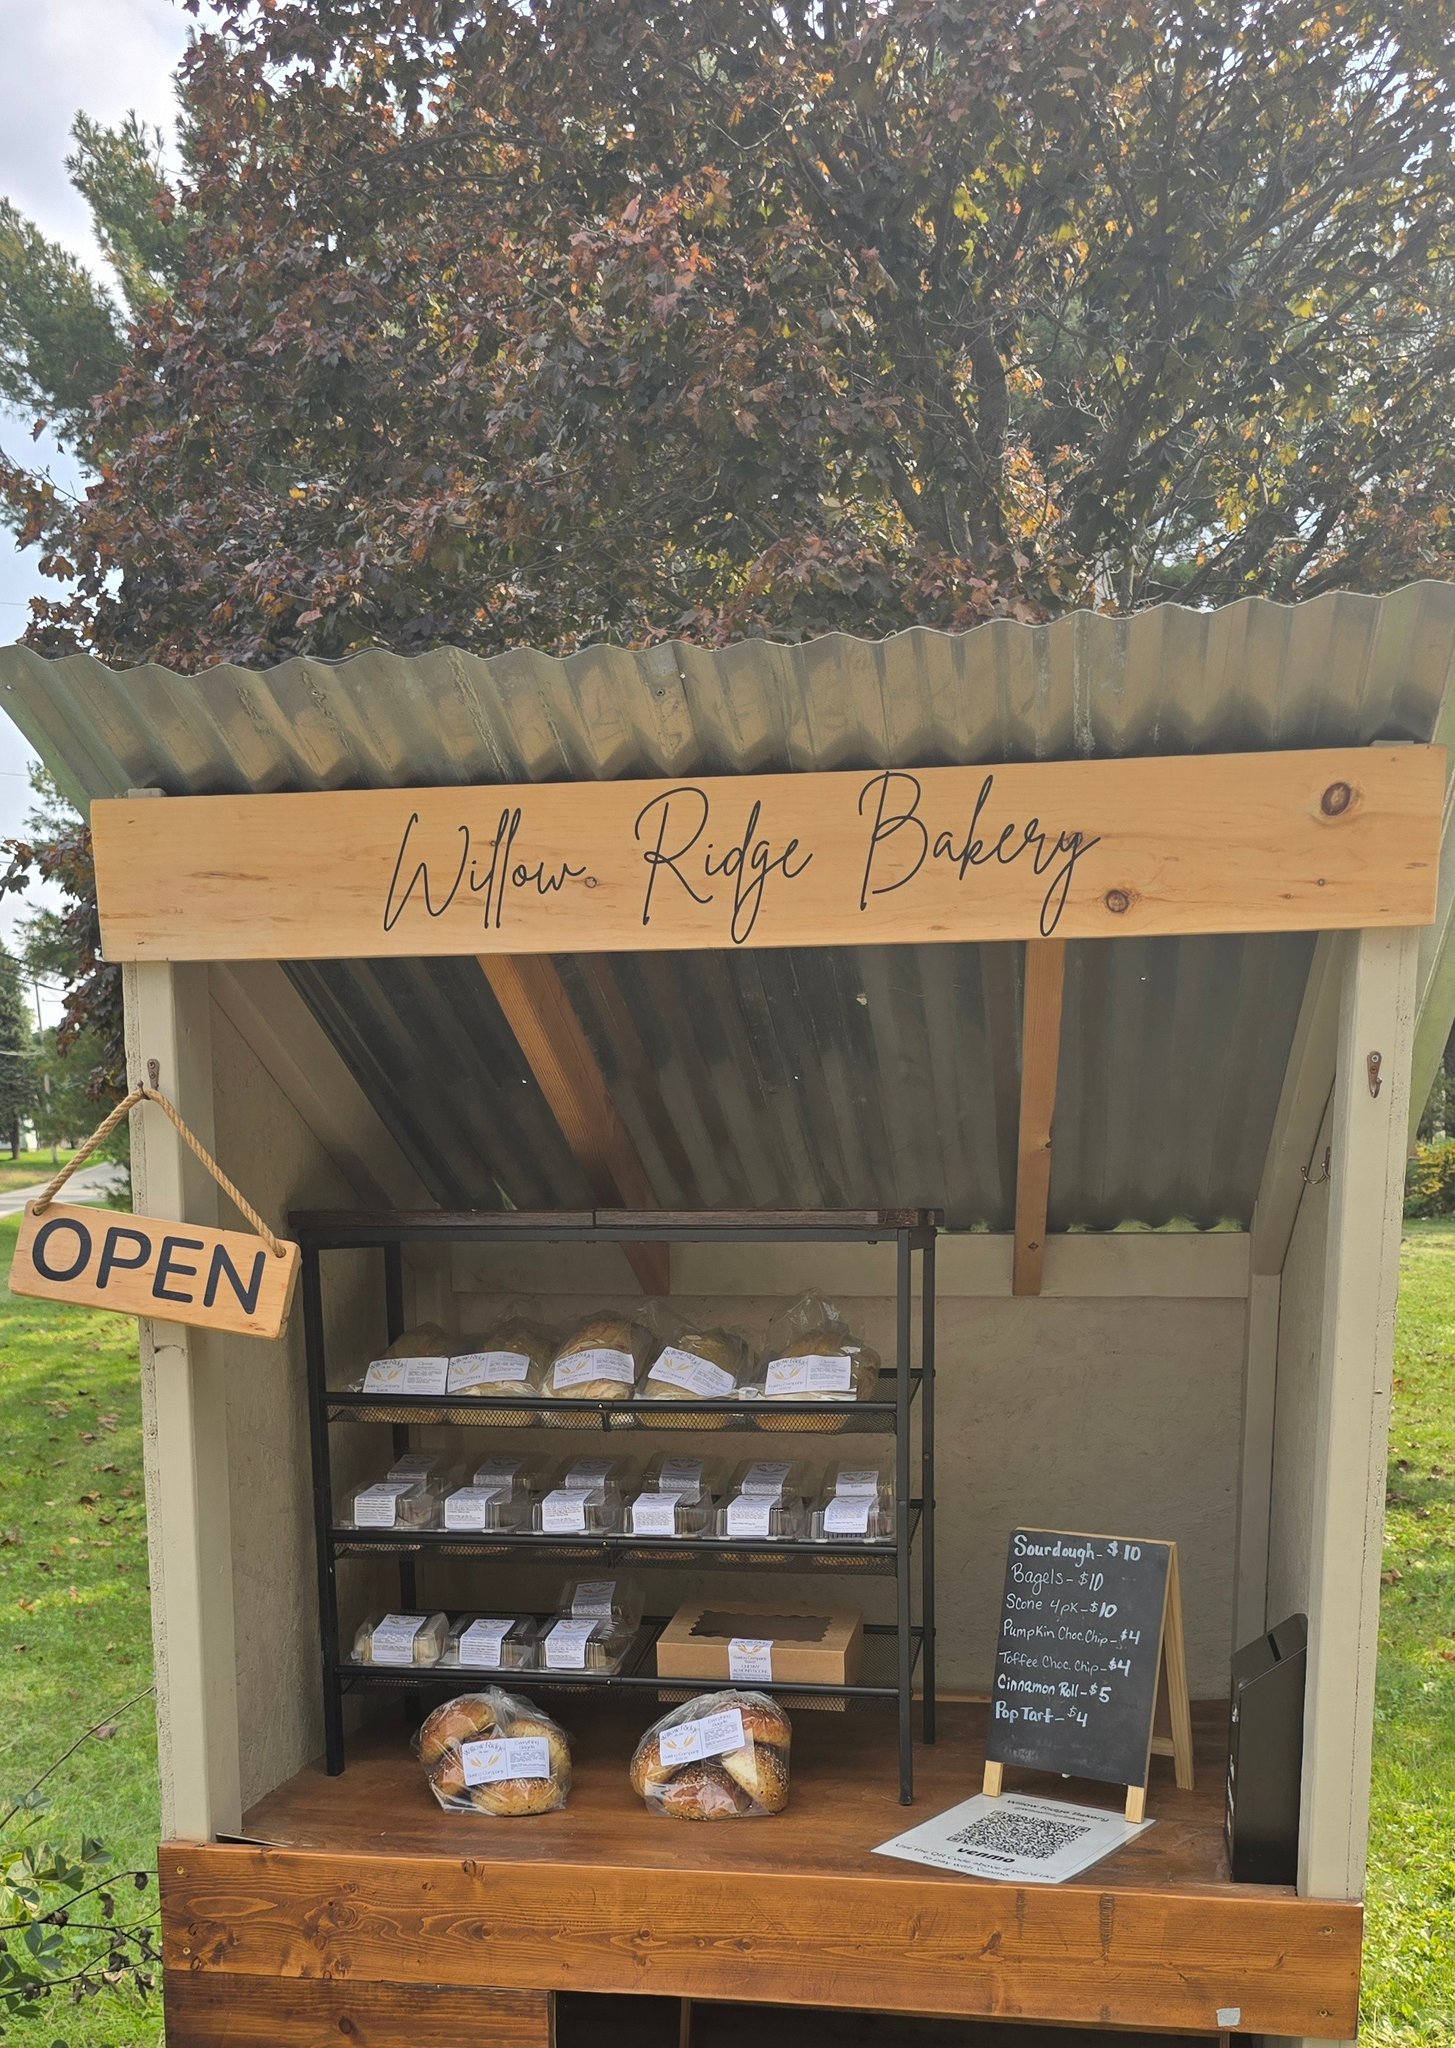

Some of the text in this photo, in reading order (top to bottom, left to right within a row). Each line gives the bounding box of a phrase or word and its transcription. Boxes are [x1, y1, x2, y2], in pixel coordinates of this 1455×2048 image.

[383, 771, 1101, 945] Willow Ridge Bakery
[32, 1218, 266, 1315] OPEN
[1006, 1593, 1043, 1610] Scone
[999, 1651, 1038, 1668] Toffee
[997, 1673, 1055, 1695] Cinnamon
[995, 1700, 1019, 1723] Pop
[957, 1848, 1015, 1863] venmo
